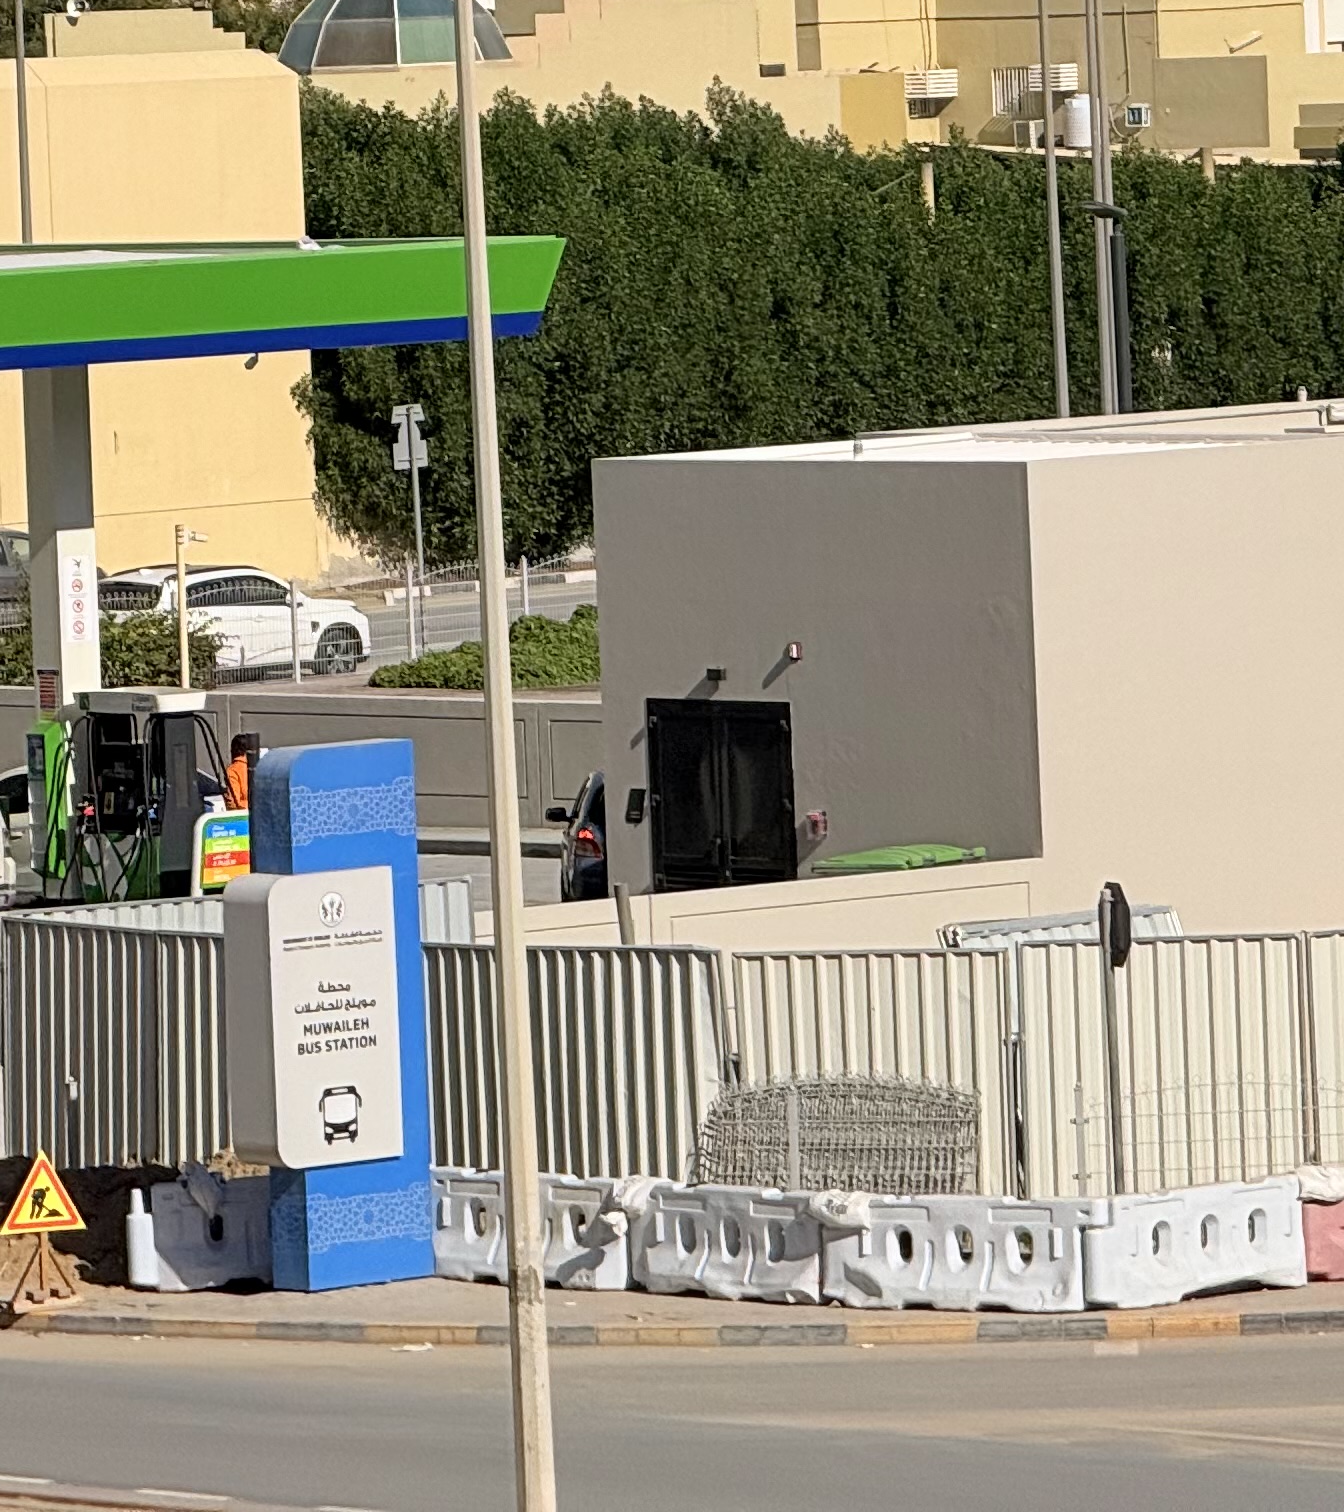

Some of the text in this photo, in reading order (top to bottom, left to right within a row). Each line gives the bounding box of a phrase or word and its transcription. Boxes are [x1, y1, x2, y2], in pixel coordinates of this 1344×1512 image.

[317, 980, 351, 994] محطة
[303, 1017, 370, 1037] MUWAILEH
[297, 1034, 377, 1056] BUS STATION
